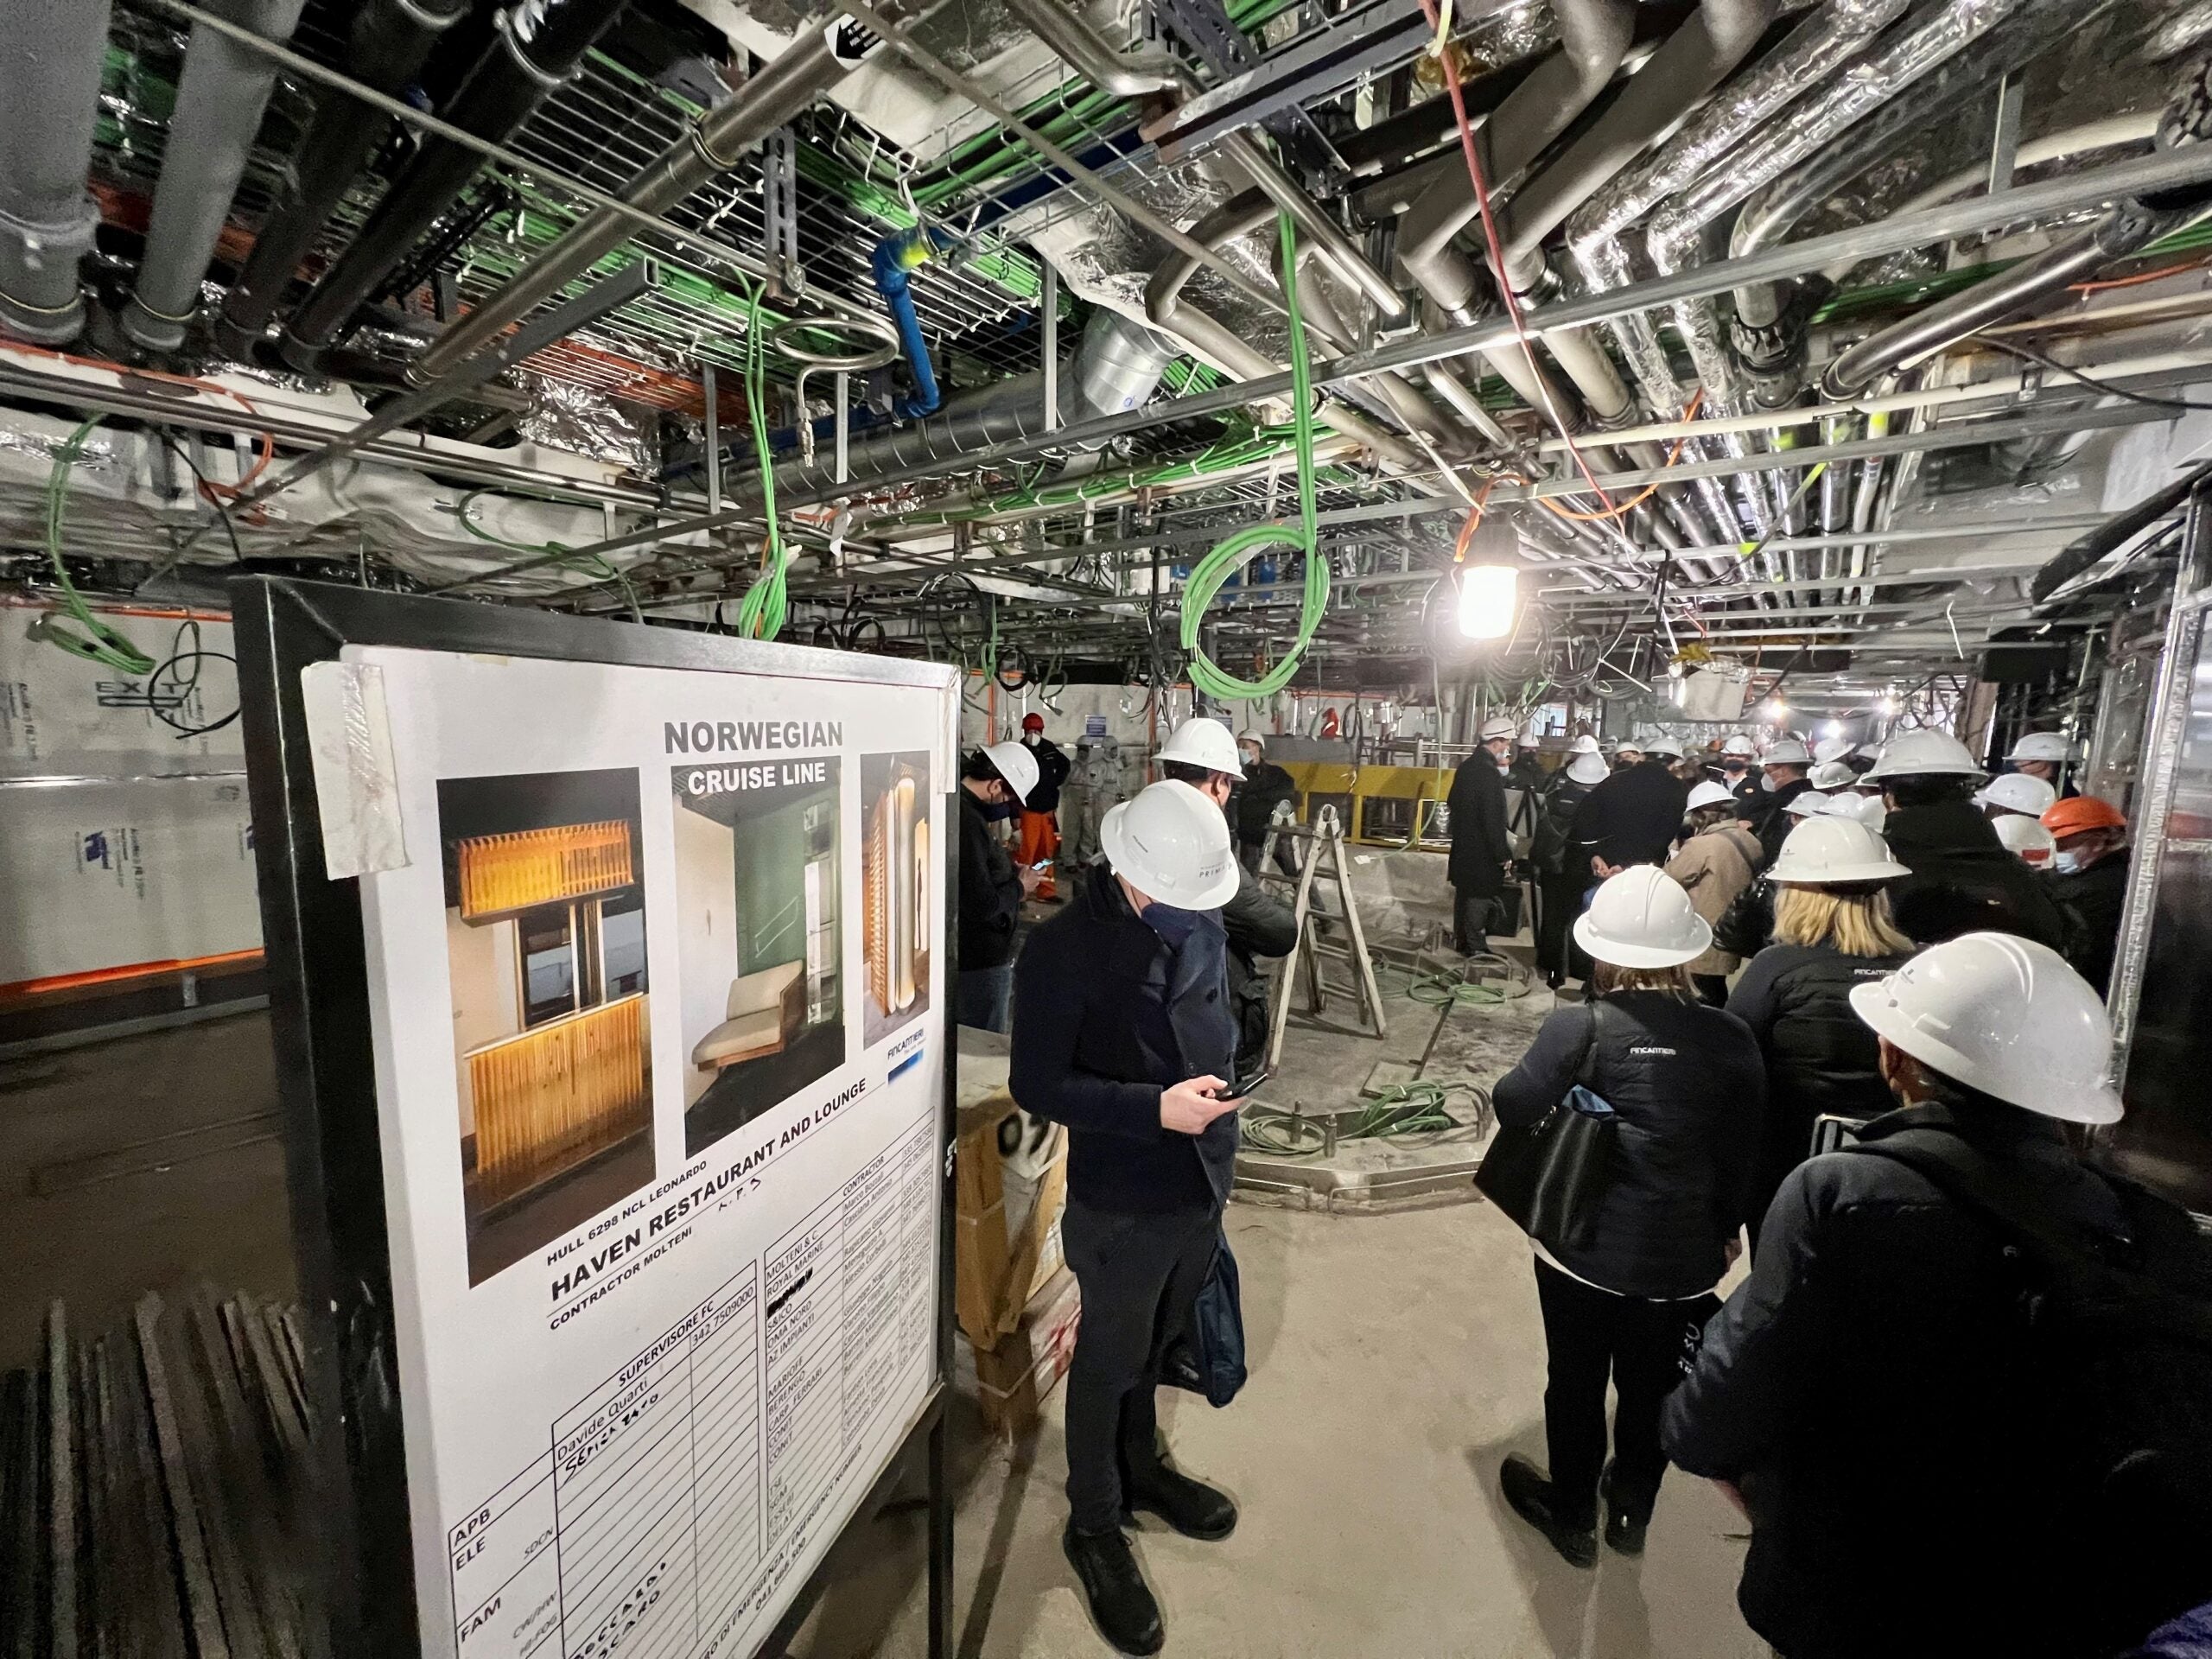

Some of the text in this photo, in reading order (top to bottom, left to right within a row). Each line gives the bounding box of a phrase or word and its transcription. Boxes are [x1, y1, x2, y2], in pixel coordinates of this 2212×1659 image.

[664, 721, 843, 754] NORWEGIAN
[688, 762, 826, 795] CRUISE LINE
[1630, 1047, 1676, 1056] FINCANTIERI
[551, 1078, 866, 1301] HAVEN RESTAURANT AND LOUNGE
[843, 1154, 883, 1198] CONTRACTOR
[546, 1160, 707, 1267] HULL 6298 NCL LEONARDO
[550, 1226, 693, 1331] CONTRACTOR MOLTENI
[766, 1241, 803, 1281] MOLTENI
[804, 1235, 810, 1249] &
[767, 1239, 823, 1300] ROYAL MARINE
[619, 1300, 715, 1388] SUPERVISORE FC
[692, 1323, 710, 1347] 342
[767, 1298, 811, 1351] OMA NORD
[767, 1312, 814, 1367] AZ IMPIANTI
[768, 1355, 802, 1400] MARIOFF
[768, 1369, 804, 1416] BERENGO
[793, 1365, 821, 1405] FERRARI
[557, 1376, 648, 1461] Davide Quarti
[769, 1415, 791, 1450] CONIT
[769, 1430, 791, 1465] CONIT
[454, 1508, 491, 1547] APB
[524, 1526, 554, 1560] SDCN
[721, 1624, 730, 1642] DI
[732, 1552, 785, 1626] EMERGENZA
[791, 1482, 835, 1546] EMERGENCY
[835, 1443, 862, 1485] NUMBER
[455, 1536, 486, 1571] ELE
[461, 1597, 501, 1643] FAM
